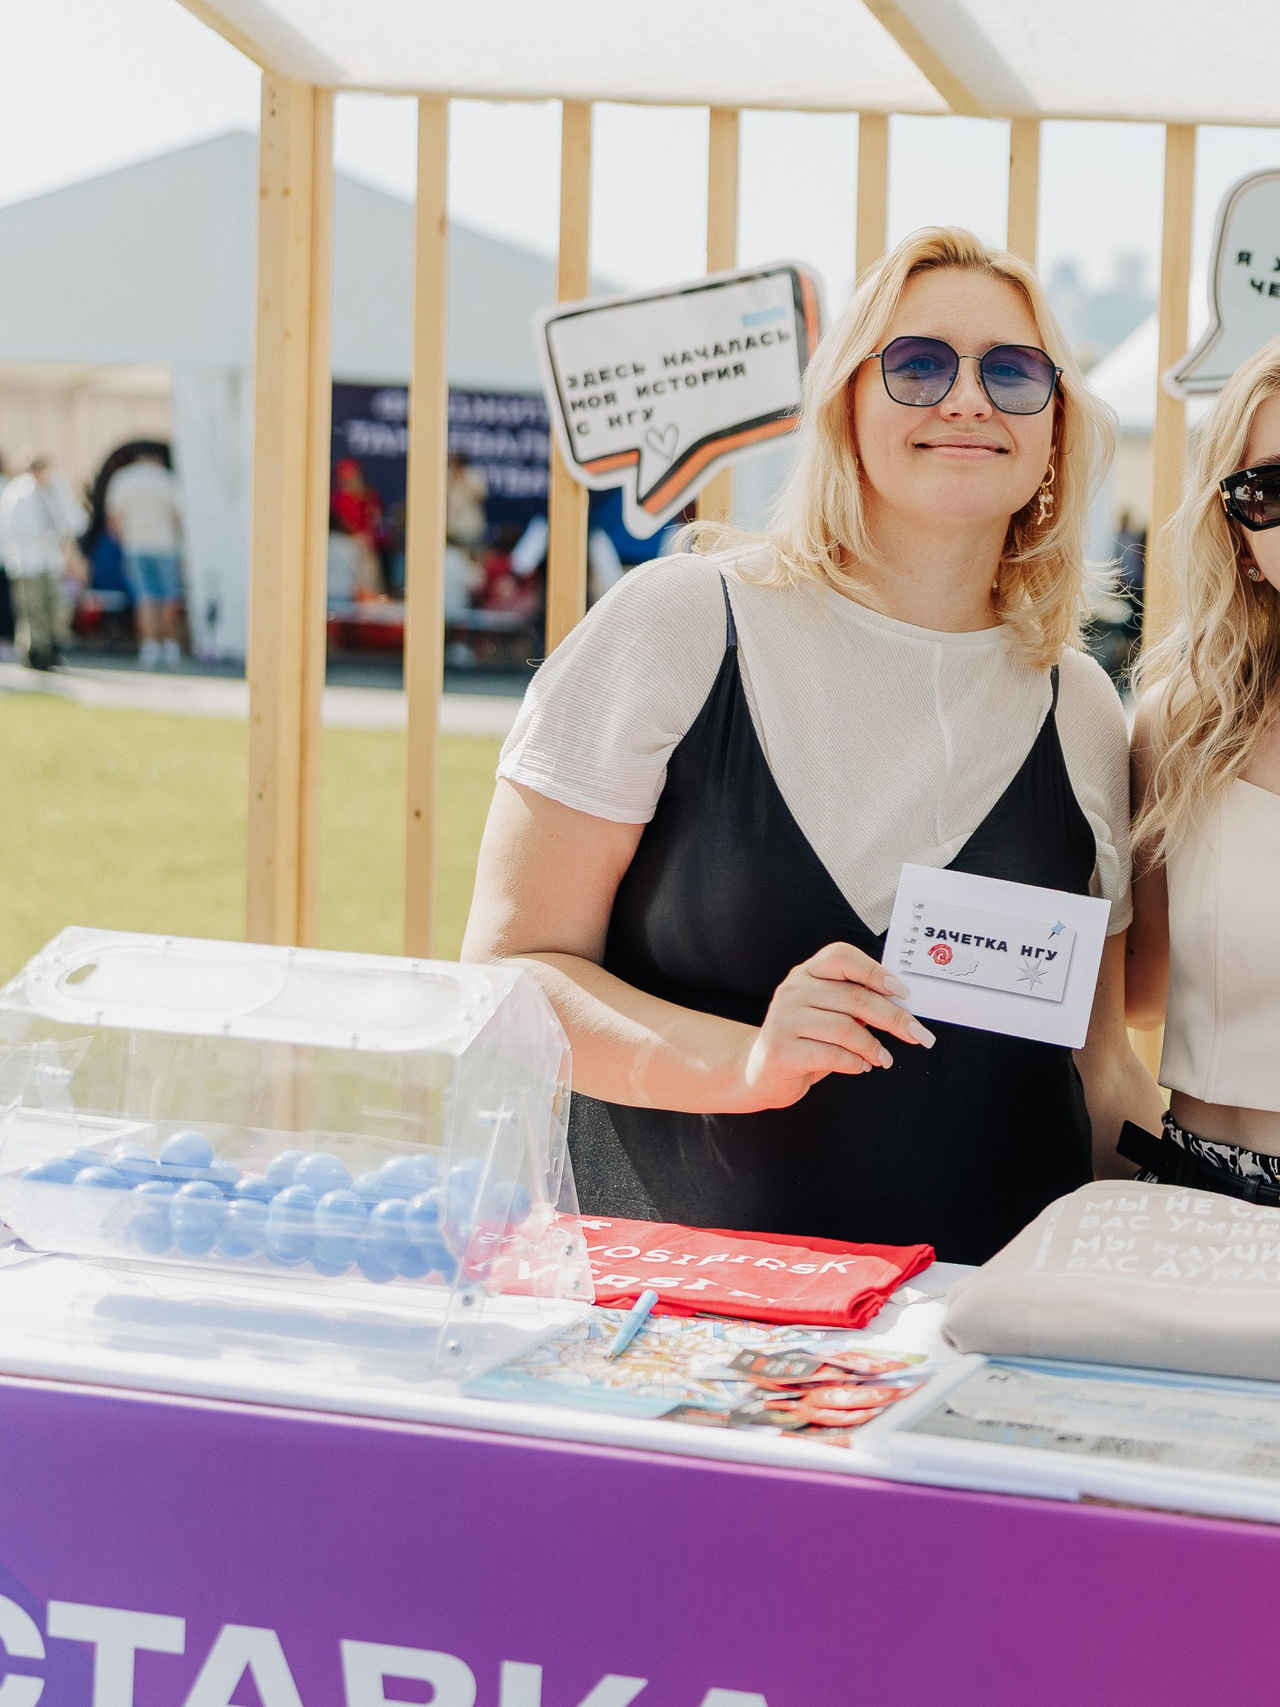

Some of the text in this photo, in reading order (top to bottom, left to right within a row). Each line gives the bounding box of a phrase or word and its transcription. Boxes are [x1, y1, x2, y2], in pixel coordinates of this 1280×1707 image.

[1236, 250, 1252, 266] Я
[567, 329, 791, 388] ЗДЕСЬ НАЧАЛАСЬ
[571, 391, 616, 412] МОЯ
[636, 363, 747, 397] ИСТОРИЯ
[576, 407, 655, 436] С НГУ
[924, 926, 1058, 962] ЗАЧЕТКА НГУ
[1083, 1194, 1148, 1214] МЫ
[1164, 1194, 1214, 1215] НЕ
[1078, 1215, 1152, 1230] ВАС
[1071, 1234, 1135, 1256] МЫ
[1066, 1256, 1140, 1274] ВАС
